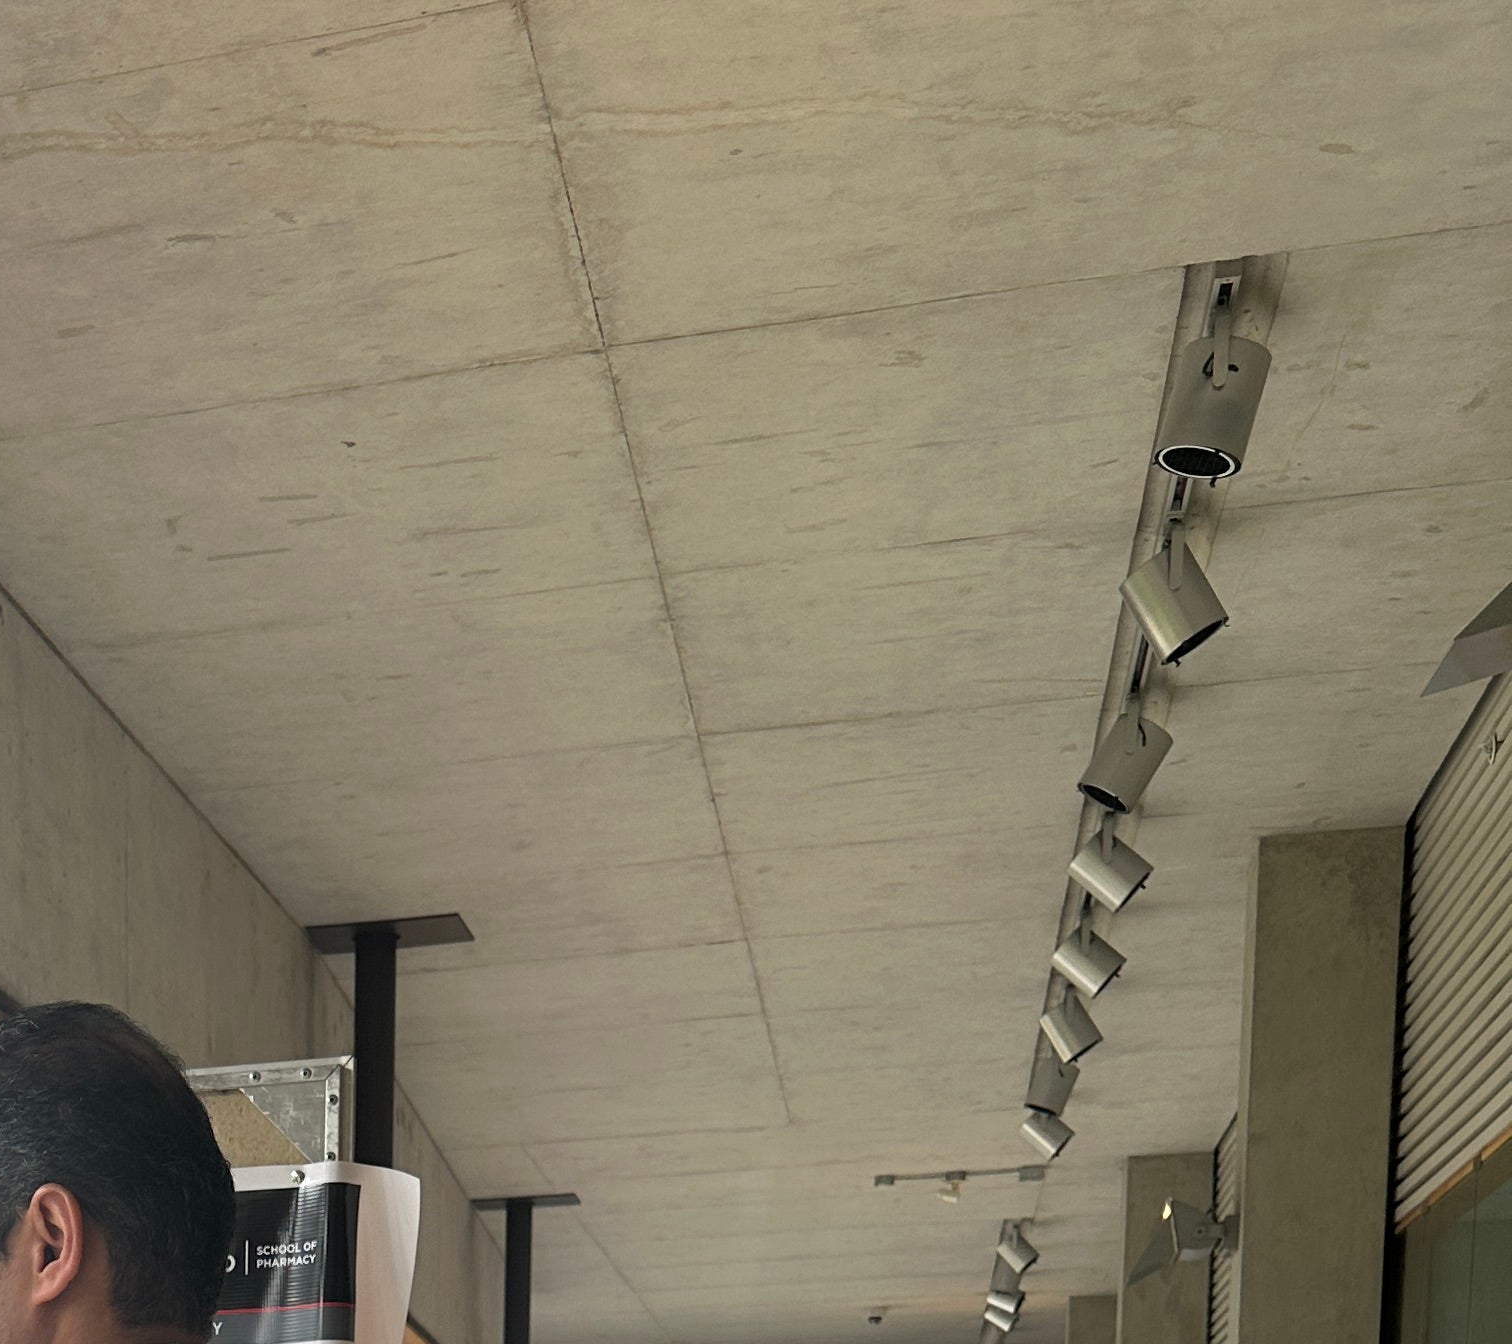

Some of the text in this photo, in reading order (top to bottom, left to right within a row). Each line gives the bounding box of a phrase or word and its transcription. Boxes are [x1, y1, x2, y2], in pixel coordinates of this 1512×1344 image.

[257, 1240, 317, 1255] SCHOOL OF
[257, 1254, 316, 1268] PHARMACY
